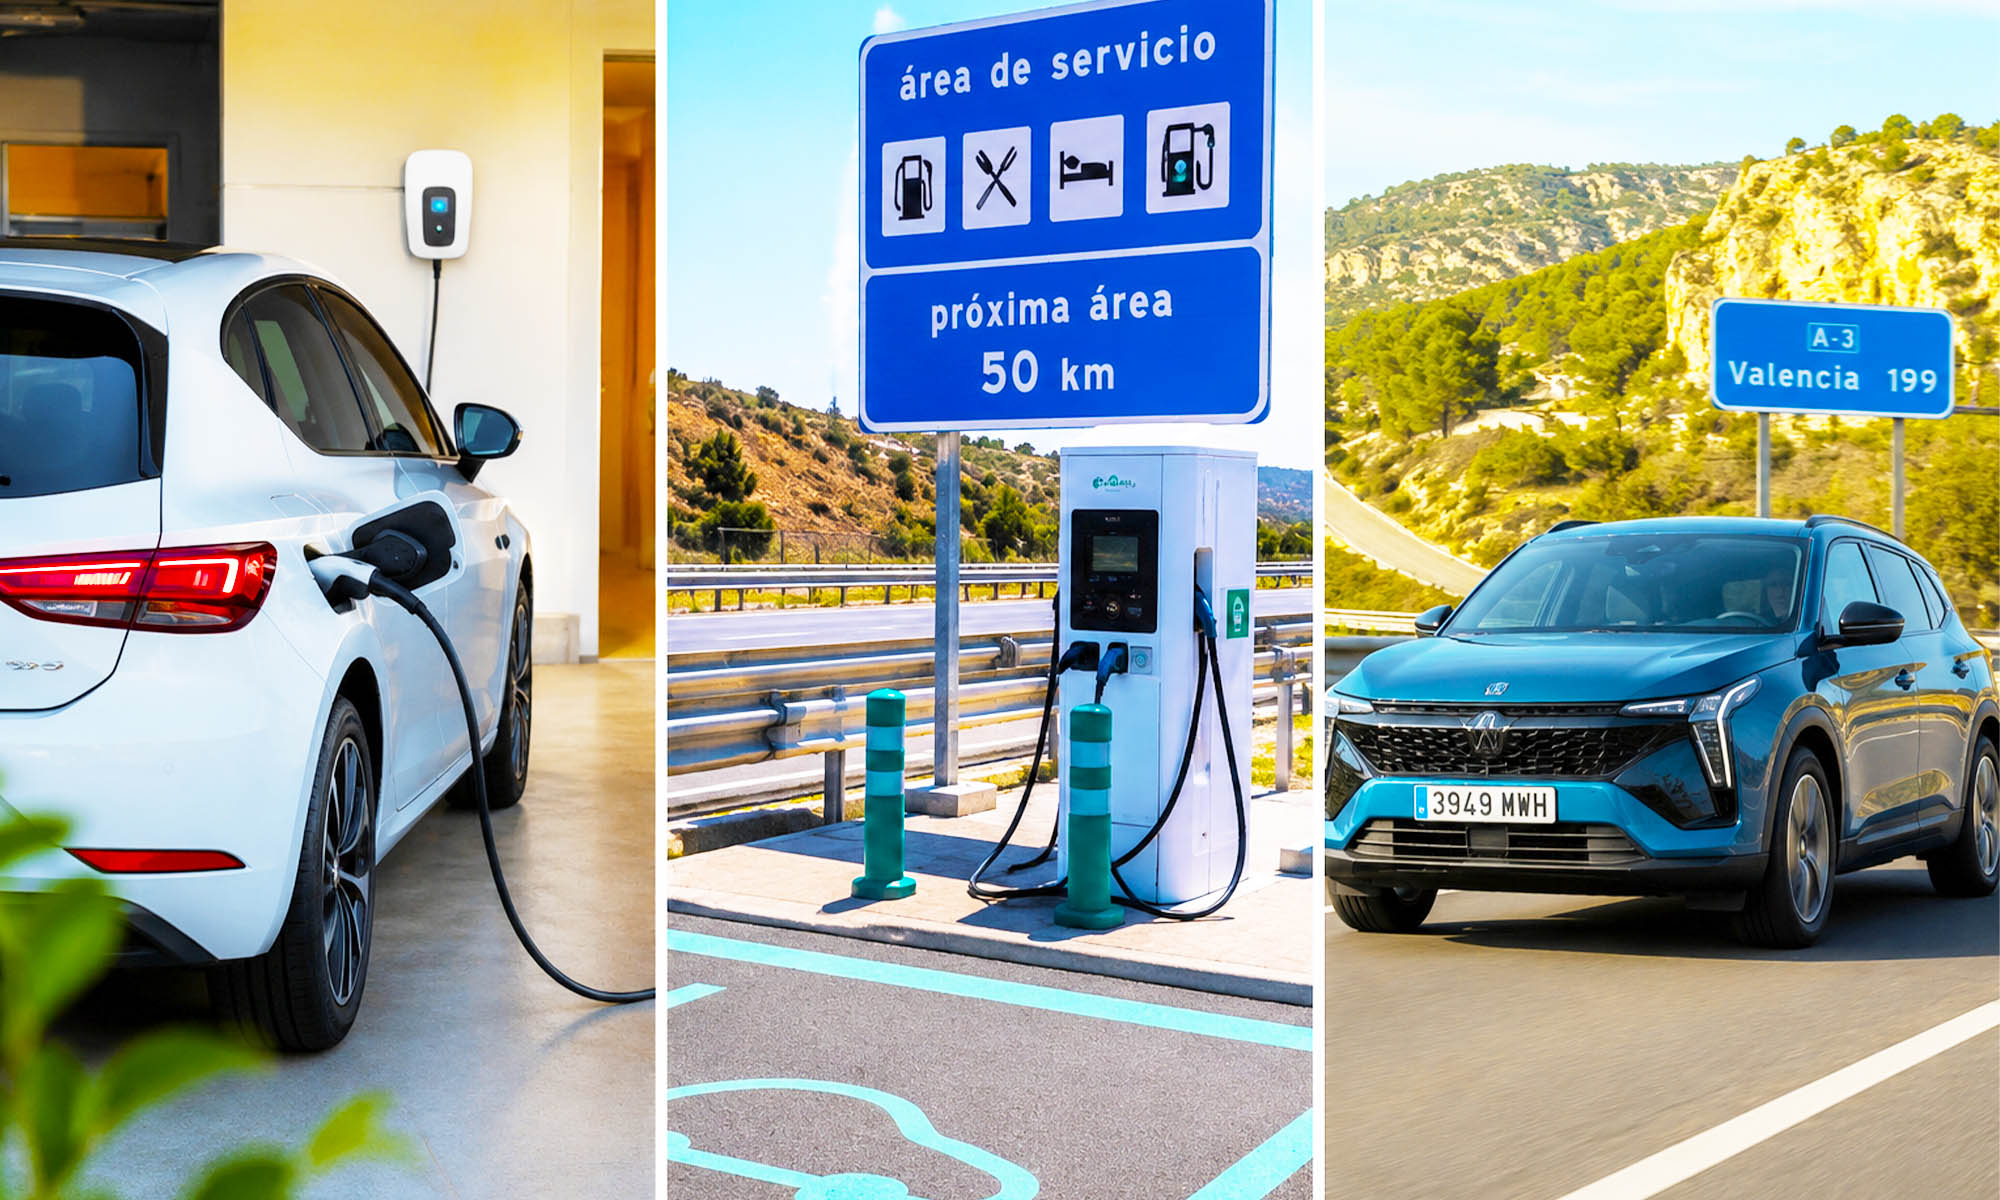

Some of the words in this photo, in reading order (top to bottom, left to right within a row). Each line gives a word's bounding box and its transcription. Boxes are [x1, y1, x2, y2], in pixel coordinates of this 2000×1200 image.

[900, 64, 971, 101] área
[990, 52, 1031, 88] de
[1051, 24, 1216, 80] servicio
[931, 291, 1070, 339] próxima
[1089, 284, 1173, 321] área
[1812, 327, 1855, 349] A-3
[981, 349, 1039, 394] 50
[1061, 357, 1114, 391] km
[1728, 360, 1860, 391] Valencia
[1887, 368, 1938, 394] 199
[1433, 791, 1492, 816] 3949
[1501, 792, 1547, 818] MWH
